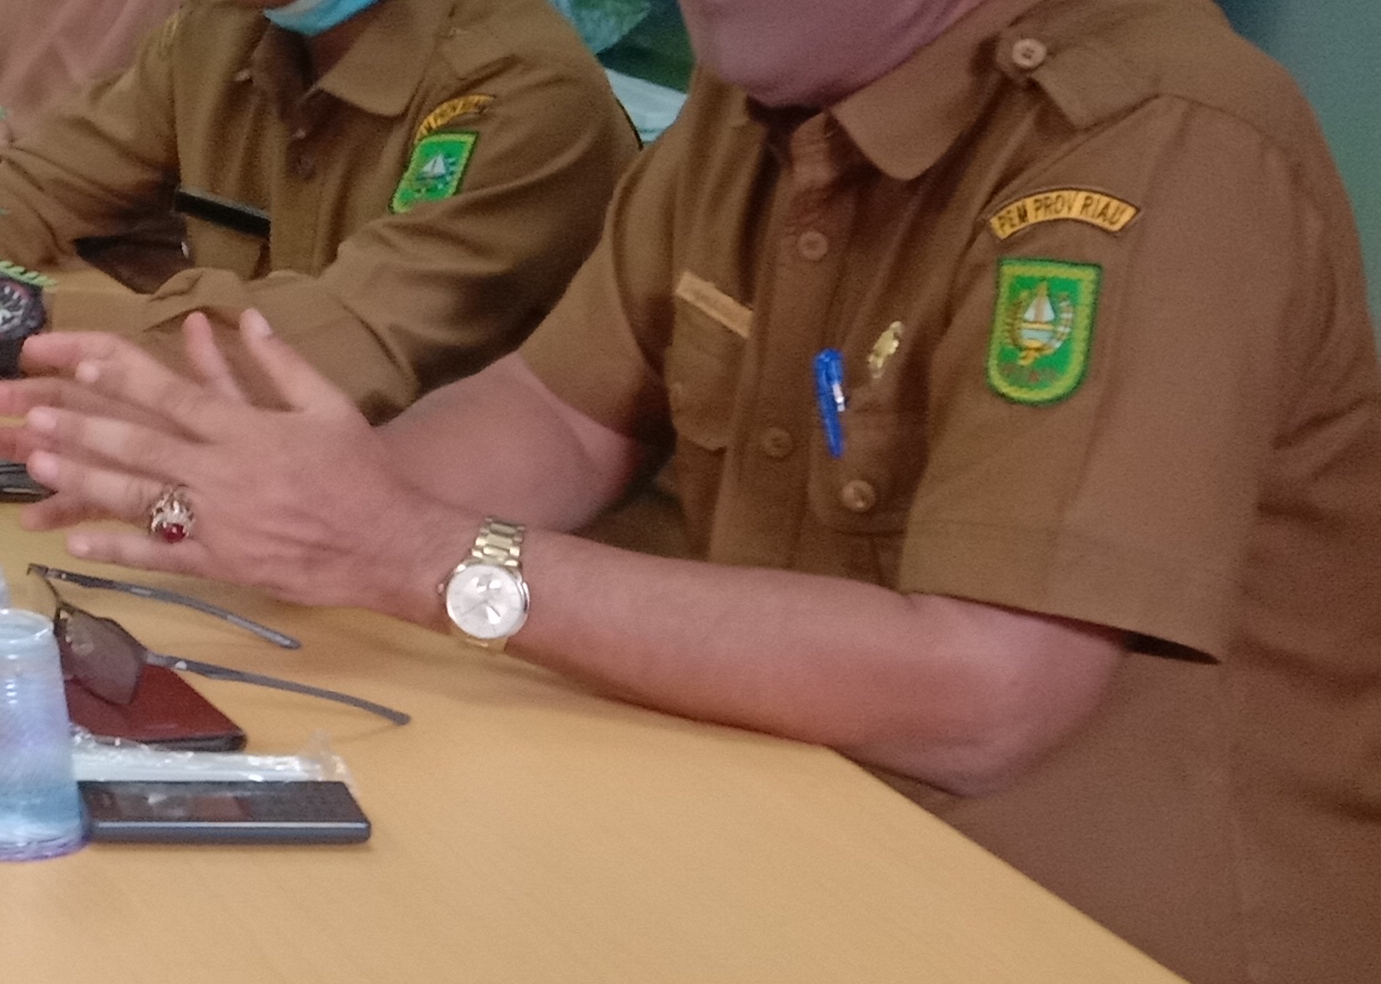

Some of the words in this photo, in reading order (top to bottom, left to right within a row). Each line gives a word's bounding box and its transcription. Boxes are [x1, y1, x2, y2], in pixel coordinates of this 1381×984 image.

[997, 203, 1029, 233] PEM
[1033, 191, 1078, 219] PROV
[1080, 195, 1127, 226] RIAU
